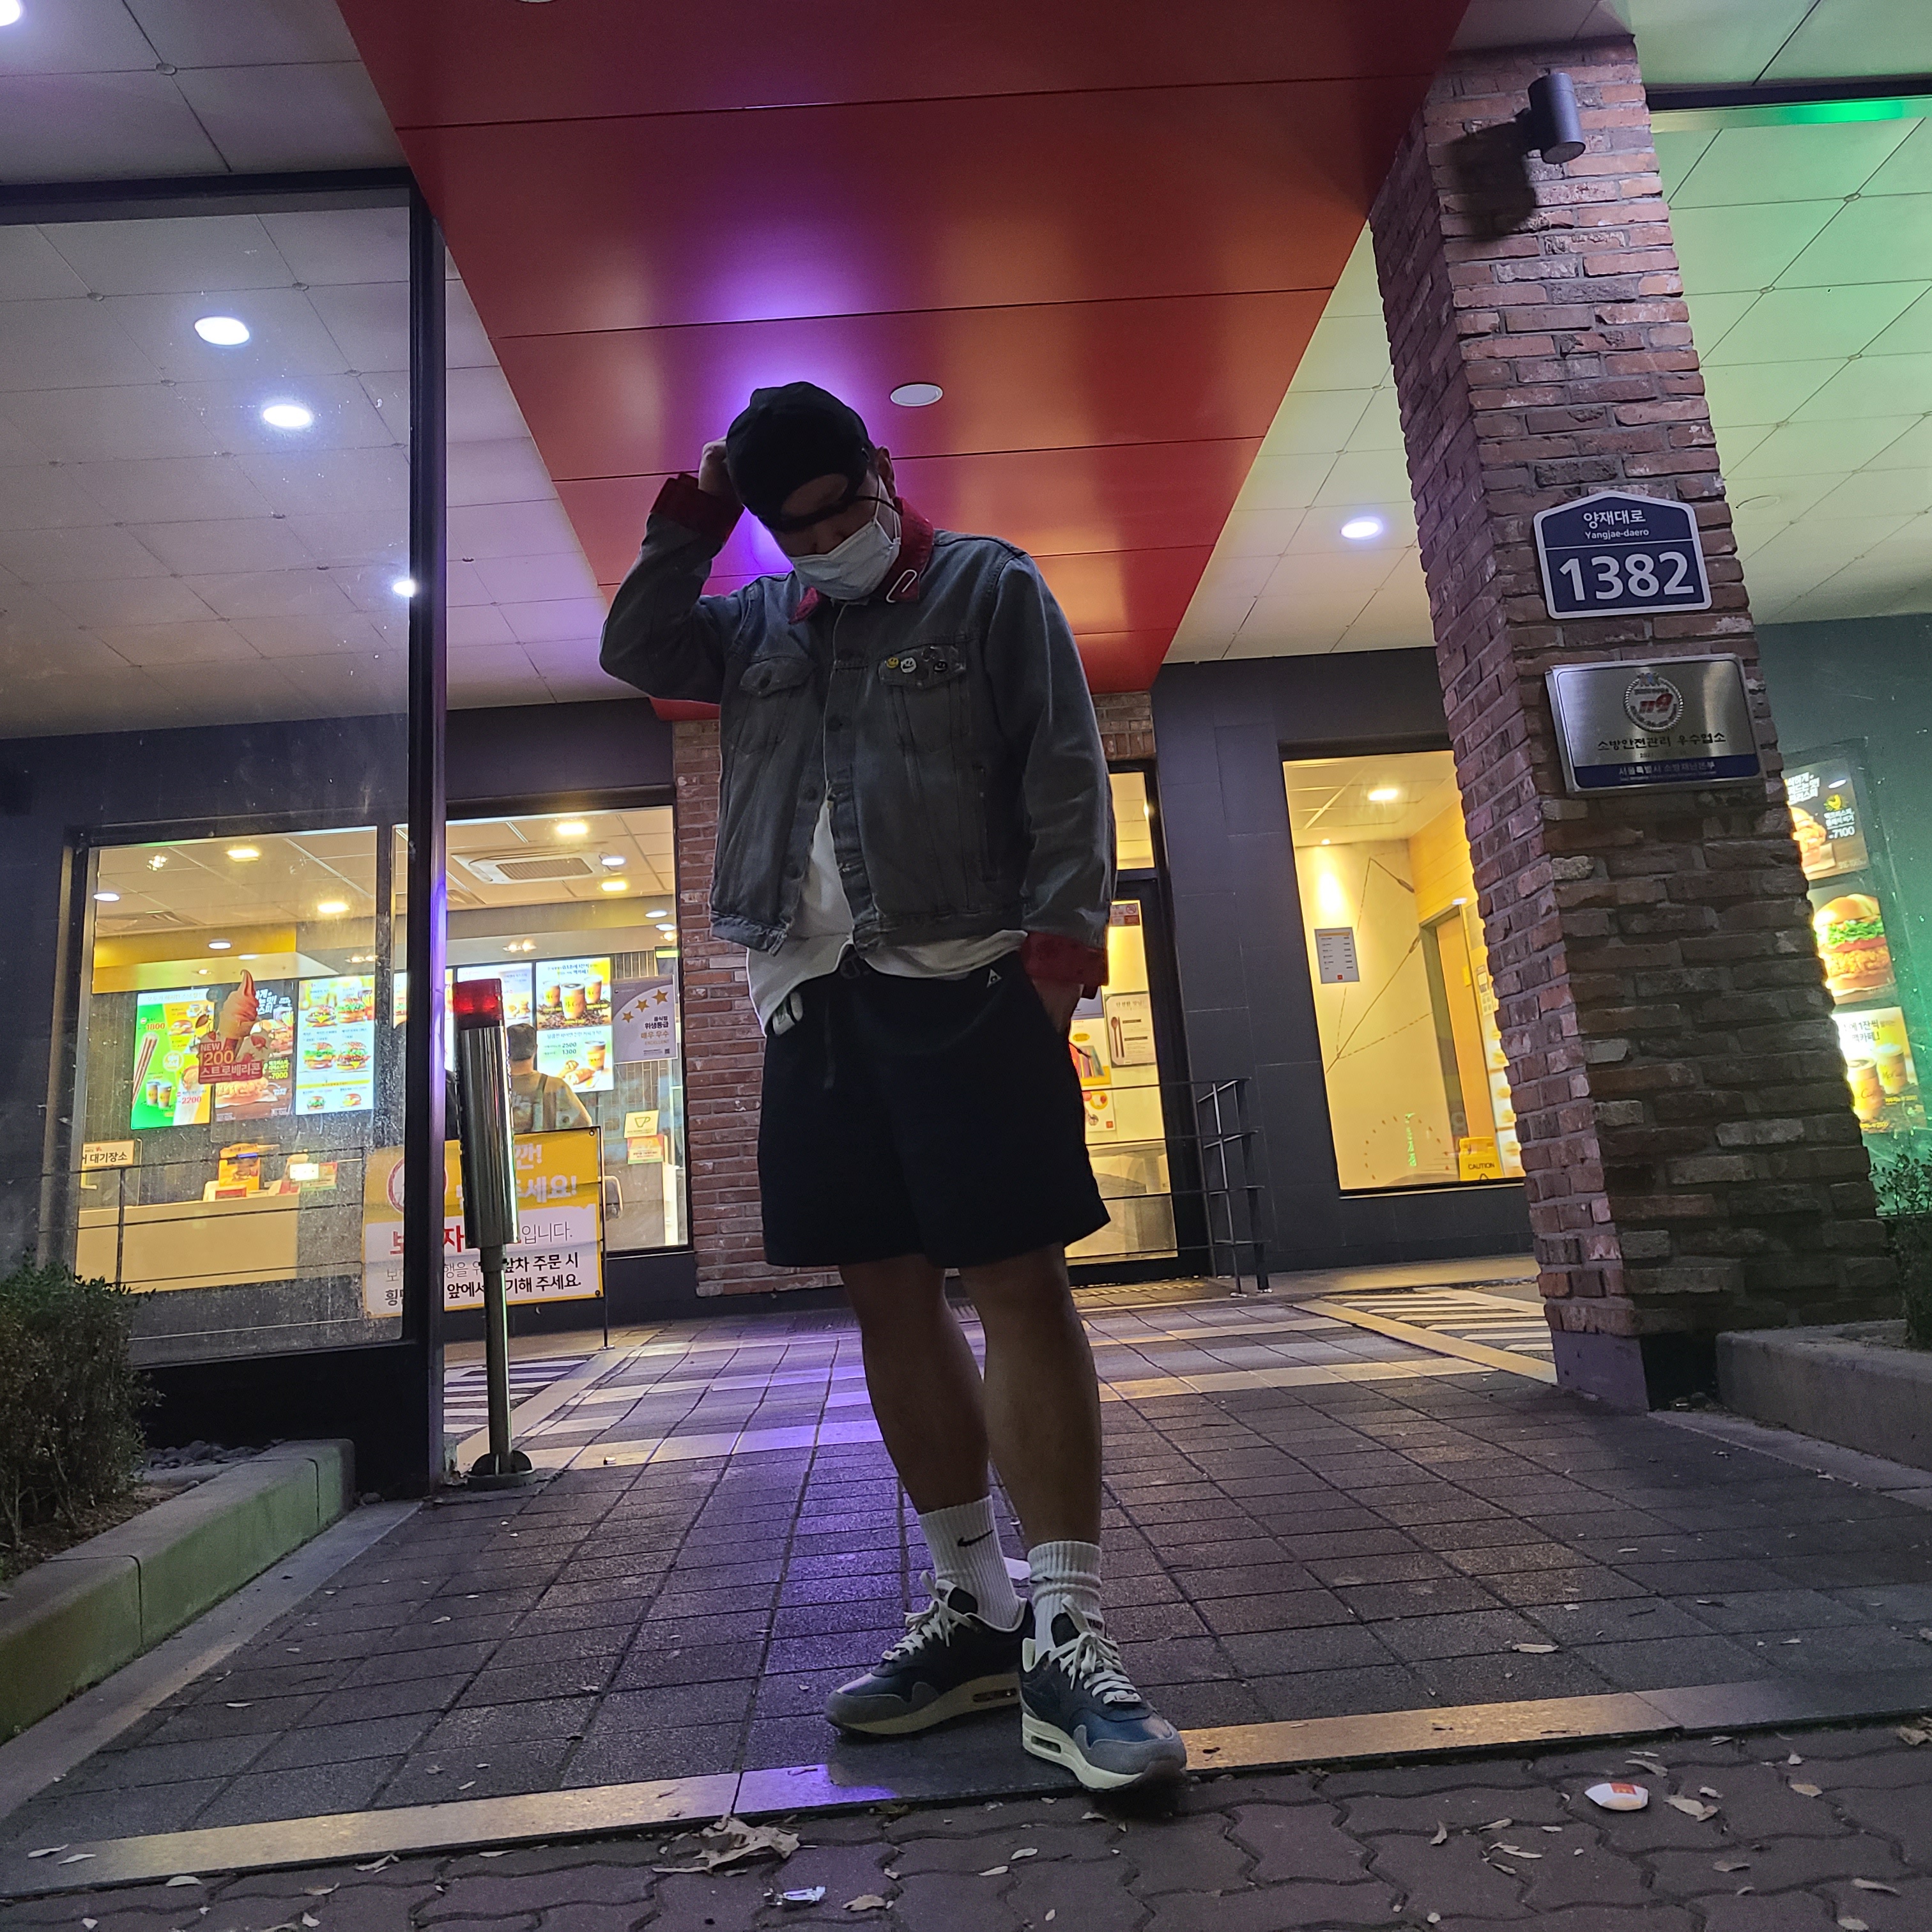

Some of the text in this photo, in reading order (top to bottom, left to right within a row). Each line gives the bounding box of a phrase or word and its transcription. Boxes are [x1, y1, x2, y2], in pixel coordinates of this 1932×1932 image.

[1583, 509, 1646, 530] 양재대로
[1585, 529, 1650, 540] Yangjae-daero
[1559, 551, 1695, 601] 1382
[1598, 732, 1726, 751] 소방안전관리 우수업소
[1832, 826, 1855, 839] 7100
[645, 1022, 669, 1030] 위생등급
[656, 1030, 669, 1038] 우수
[200, 1042, 220, 1051] NEW
[197, 1050, 234, 1066] 1200
[201, 1062, 261, 1077] 스트로베리콘
[90, 1152, 127, 1163] 대기장소
[514, 1144, 542, 1170] 깐!
[533, 1254, 562, 1271] 주문
[565, 1252, 578, 1268] 시
[505, 1277, 532, 1294] 기해
[535, 1273, 581, 1292] 주세요.
